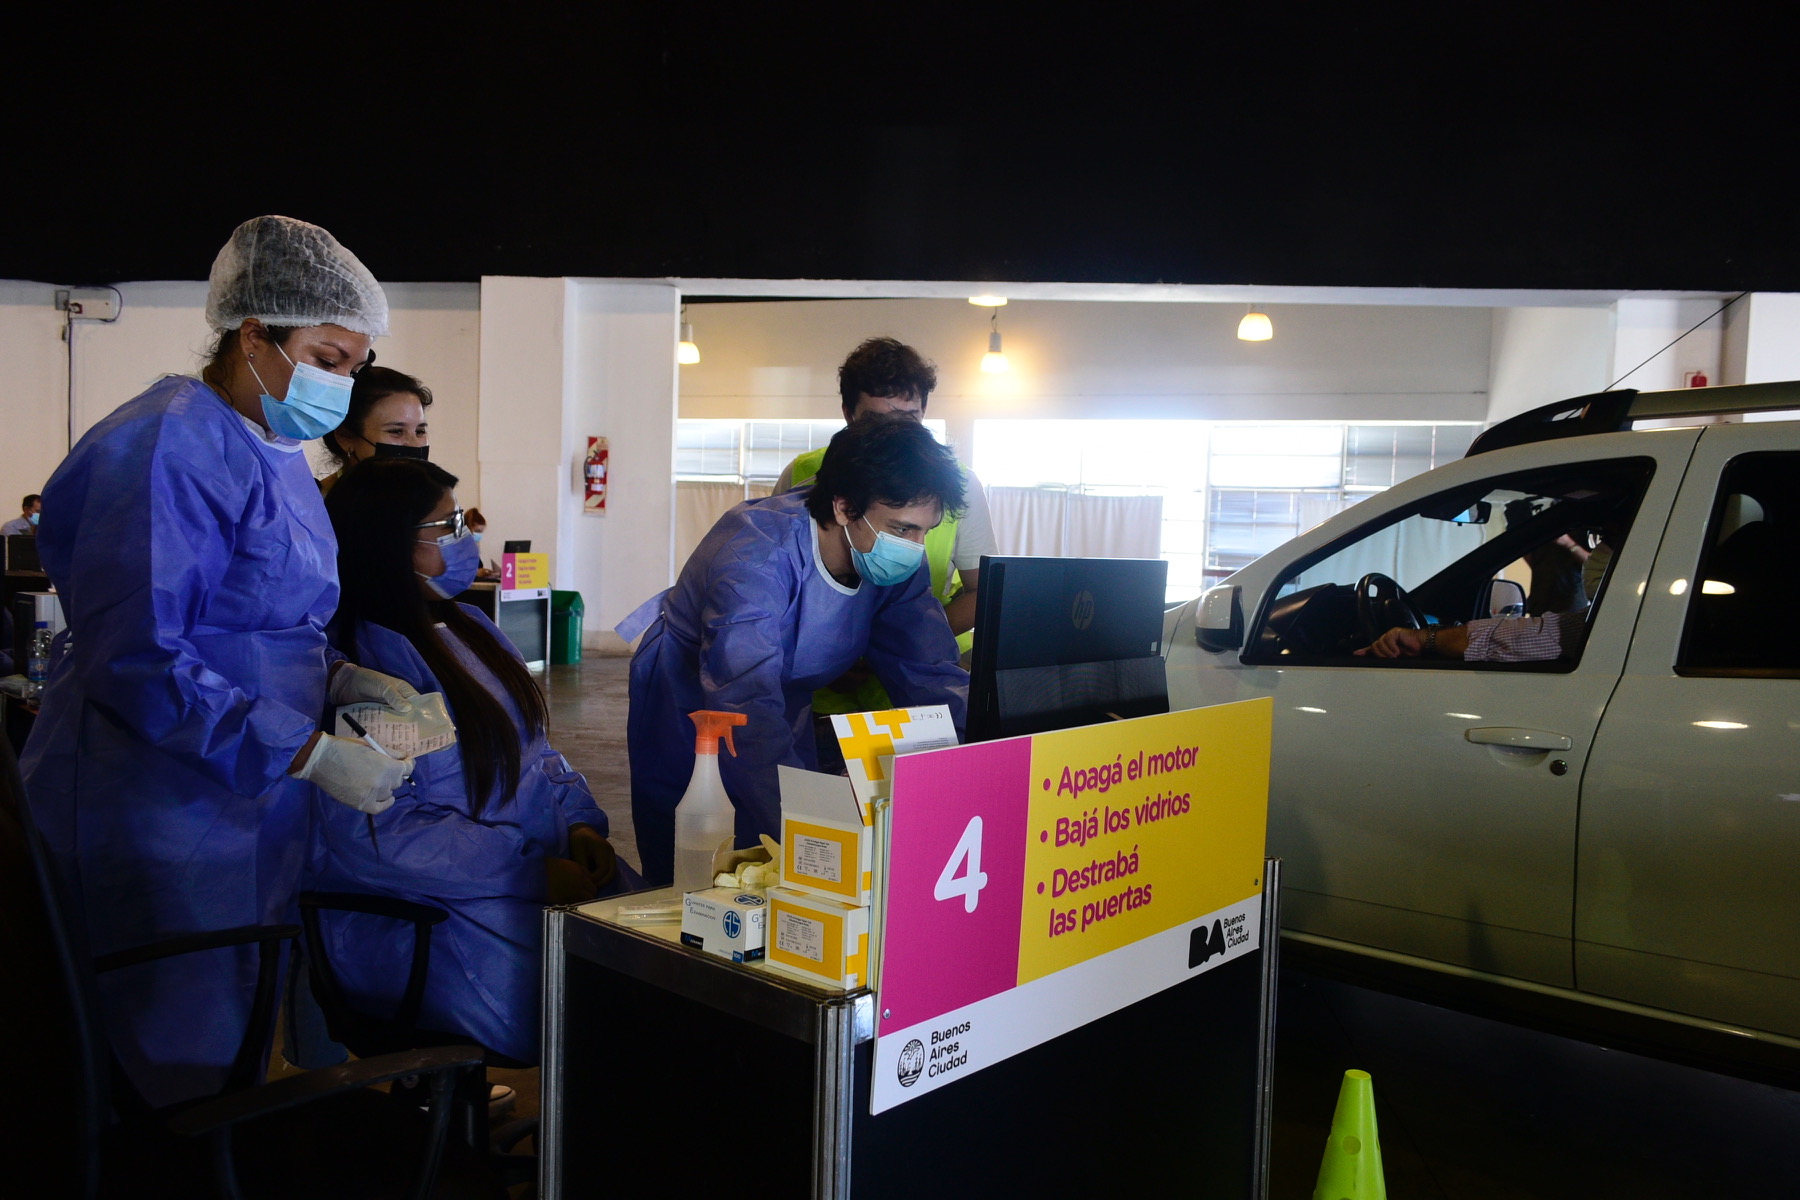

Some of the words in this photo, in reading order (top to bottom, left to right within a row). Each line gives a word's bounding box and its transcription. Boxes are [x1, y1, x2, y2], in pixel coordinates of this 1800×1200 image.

[506, 562, 513, 578] 2
[1073, 590, 1094, 630] hp
[1057, 754, 1122, 800] Apagá
[1127, 751, 1144, 782] el
[1147, 744, 1199, 777] motor
[1055, 808, 1098, 847] Bajá
[1103, 808, 1130, 835] los
[1134, 790, 1191, 825] vidrios
[933, 815, 988, 914] 4
[1051, 844, 1139, 899] Destrabá
[1048, 907, 1076, 938] las
[1081, 881, 1152, 932] puertas
[1223, 913, 1246, 929] Buenos
[1188, 919, 1226, 970] BA
[1226, 925, 1243, 938] Aires
[1227, 930, 1250, 948] Ciudad
[930, 1021, 971, 1045] Buenos
[928, 1050, 968, 1078] Ciudad
[929, 1041, 960, 1062] Aires
